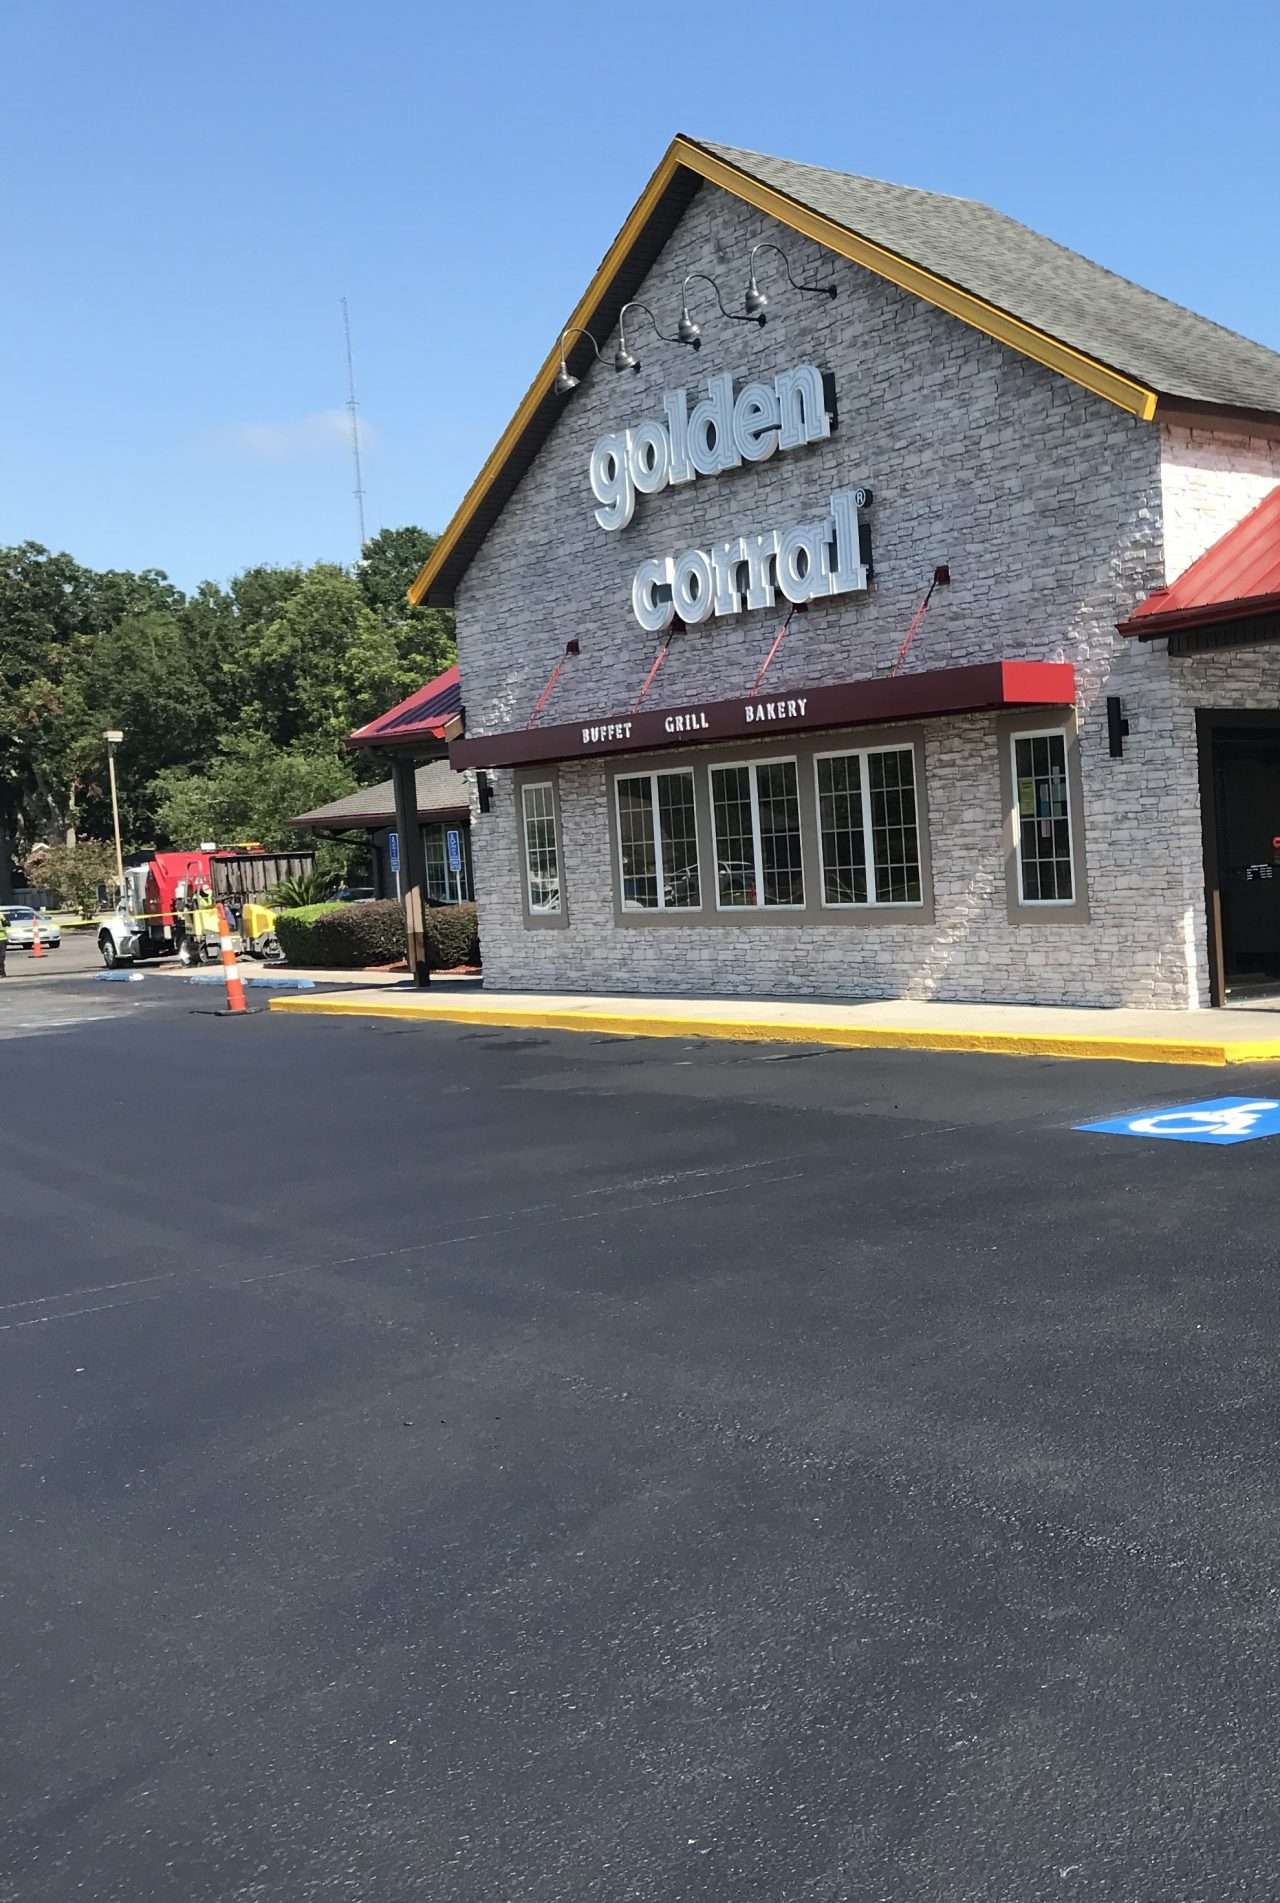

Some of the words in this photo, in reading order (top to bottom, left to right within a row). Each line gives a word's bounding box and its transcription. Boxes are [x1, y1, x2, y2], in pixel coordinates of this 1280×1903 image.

[589, 364, 831, 531] golden
[582, 722, 632, 744] BUFFET
[664, 712, 709, 733] GRILL
[745, 698, 807, 722] BAKERY
